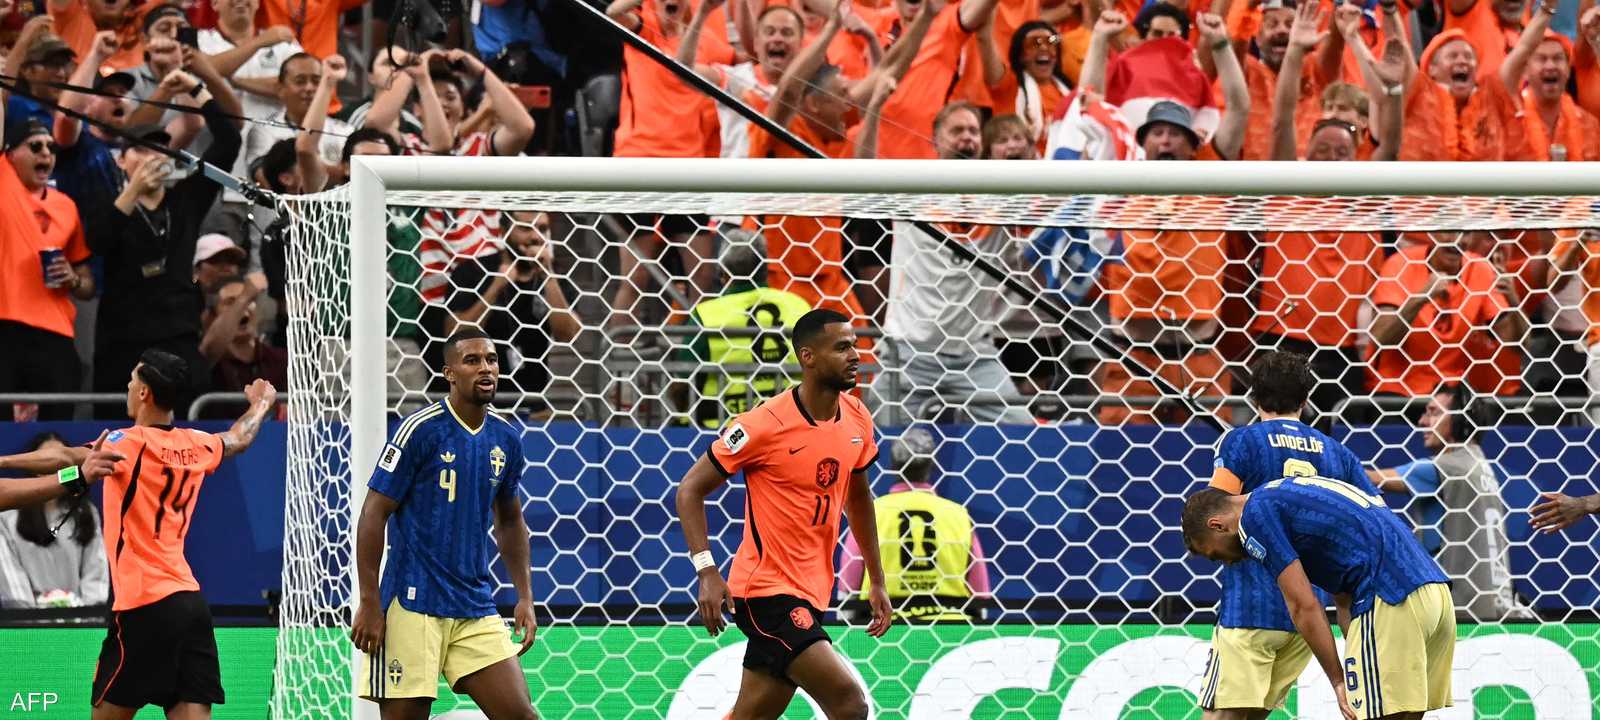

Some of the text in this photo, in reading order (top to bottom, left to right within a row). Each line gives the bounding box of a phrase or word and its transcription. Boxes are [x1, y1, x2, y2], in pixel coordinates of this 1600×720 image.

[1267, 433, 1324, 454] LINDELÖF
[154, 464, 196, 539] 14
[439, 468, 457, 503] 4
[811, 494, 830, 526] 11
[1344, 656, 1359, 692] 6
